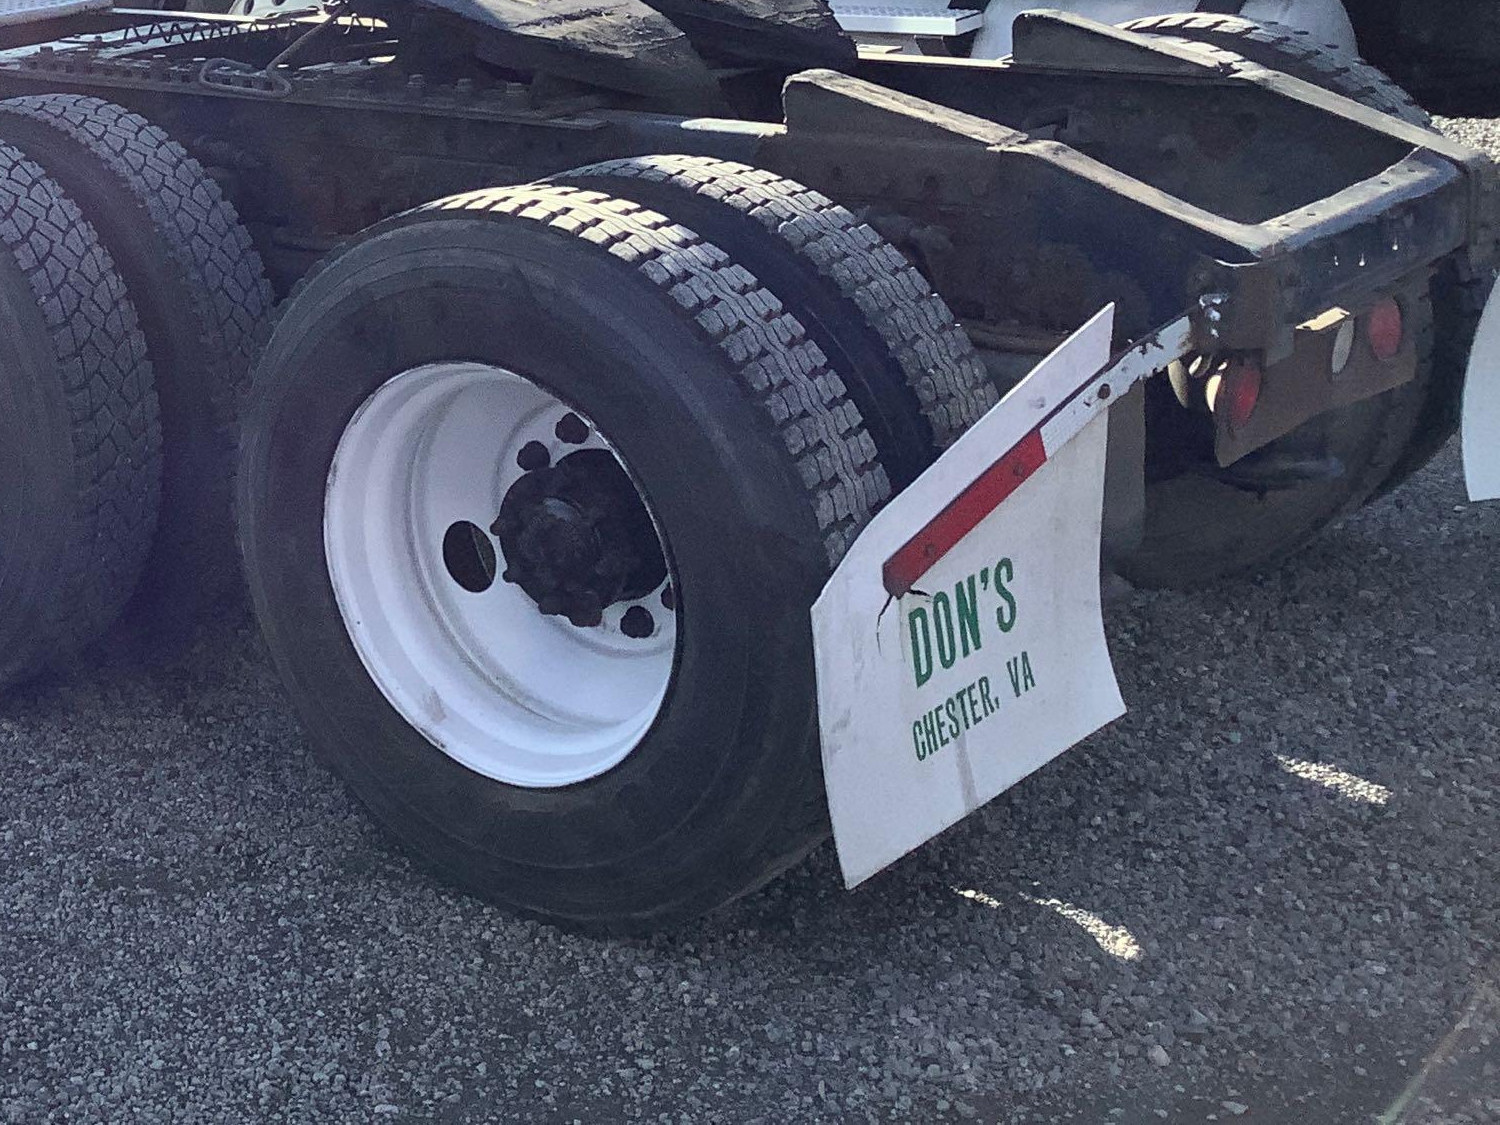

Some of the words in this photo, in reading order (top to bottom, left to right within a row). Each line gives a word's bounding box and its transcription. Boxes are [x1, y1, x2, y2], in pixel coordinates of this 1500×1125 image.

[908, 557, 1017, 689] DON'S
[912, 675, 1000, 762] CHESTER,
[1006, 651, 1036, 698] VA
